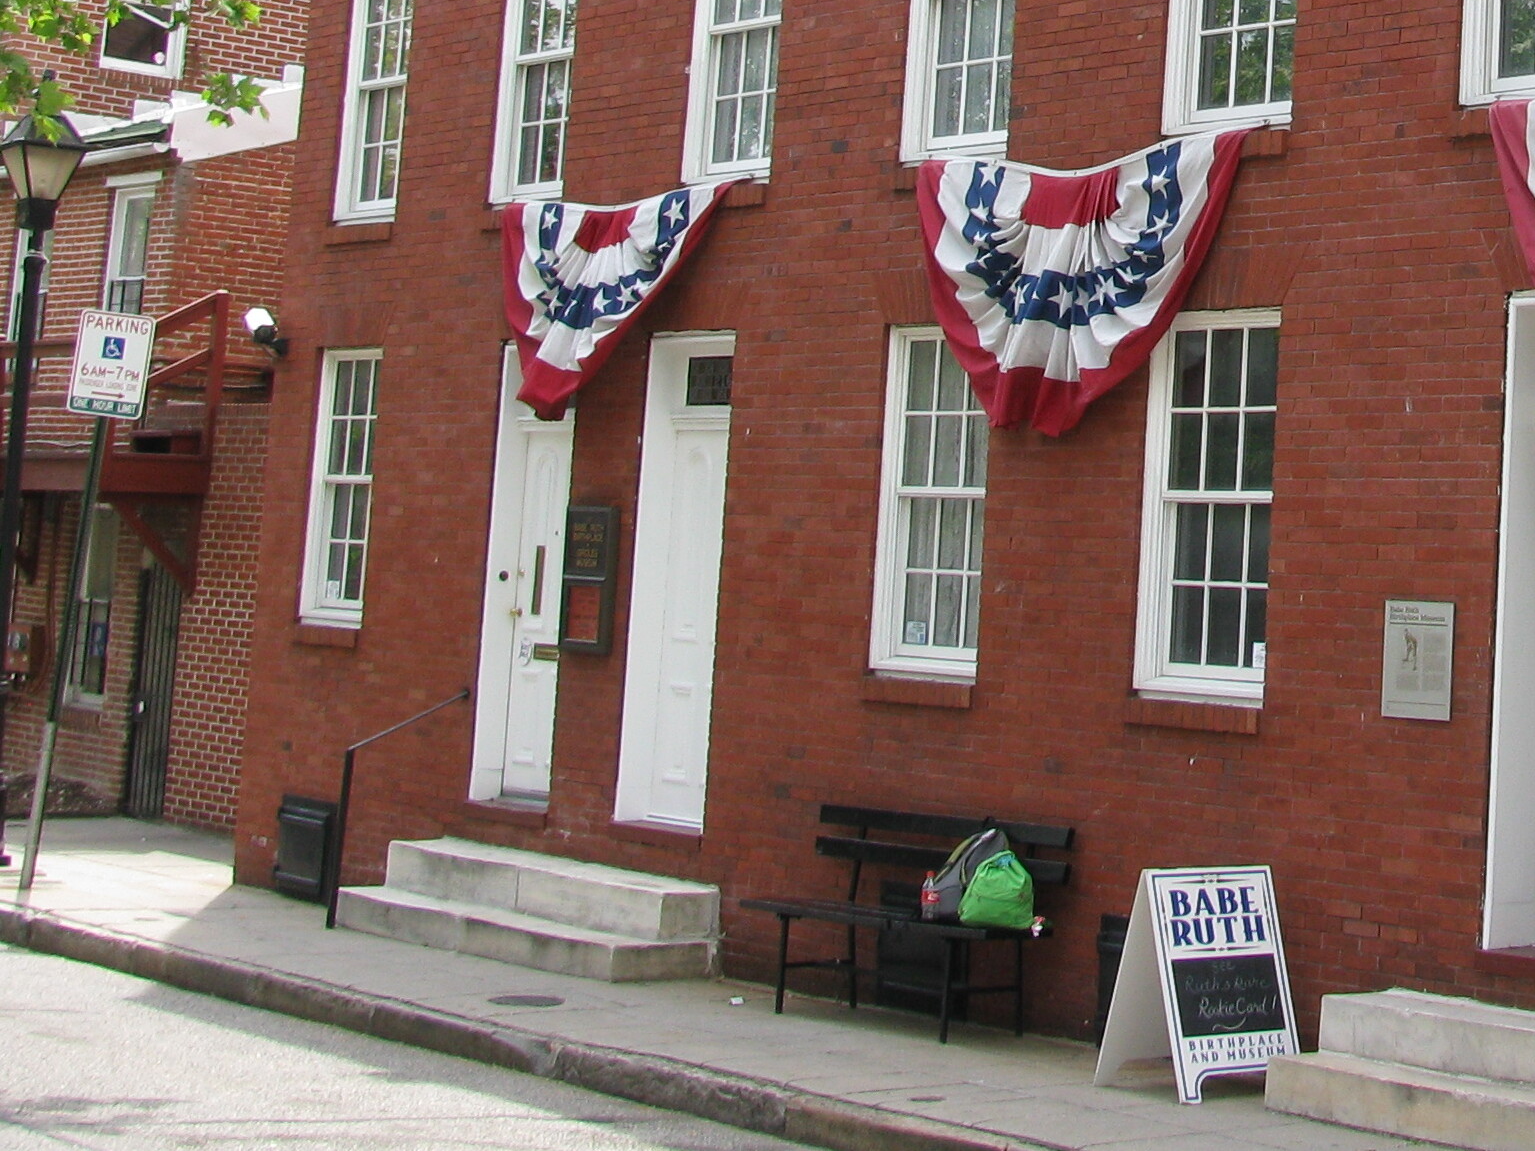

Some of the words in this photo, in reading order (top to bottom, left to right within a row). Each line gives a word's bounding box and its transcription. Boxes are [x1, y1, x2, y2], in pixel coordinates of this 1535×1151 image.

[86, 314, 149, 336] PARKING
[1168, 886, 1260, 918] BABE
[1170, 914, 1267, 947] RUTH
[1188, 1033, 1285, 1051] BIRTHPLACE
[1191, 1051, 1219, 1064] AND
[1226, 1045, 1286, 1061] MUSEUM
